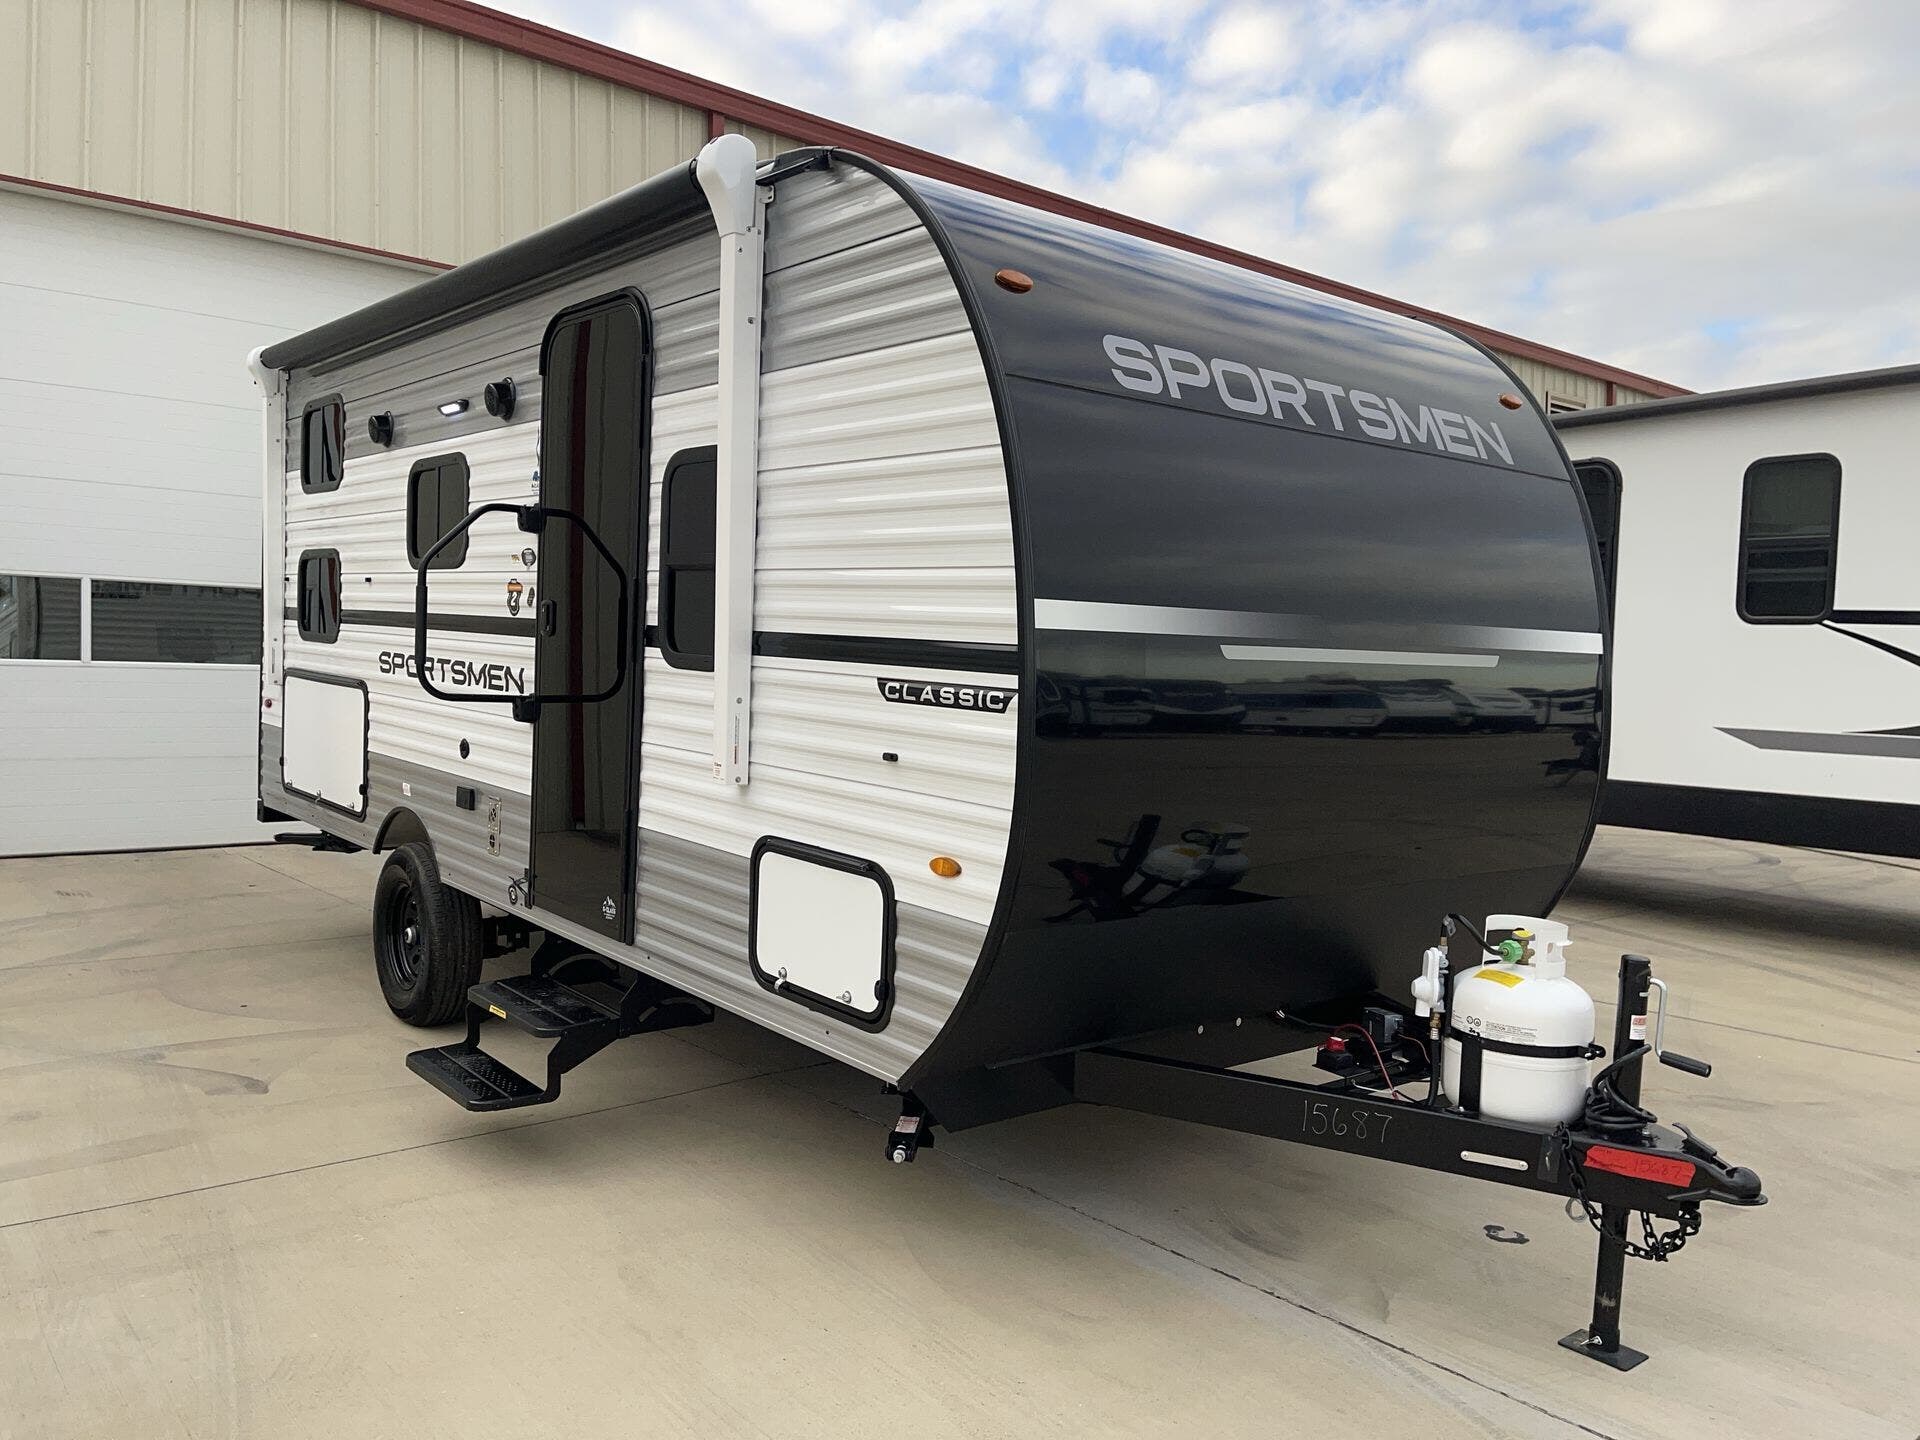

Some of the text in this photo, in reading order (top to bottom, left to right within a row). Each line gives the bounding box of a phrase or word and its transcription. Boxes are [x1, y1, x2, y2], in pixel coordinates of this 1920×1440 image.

[1102, 334, 1515, 465] SPORTSMEN
[884, 682, 1004, 710] CLASSIC
[1302, 1100, 1393, 1143] 15687
